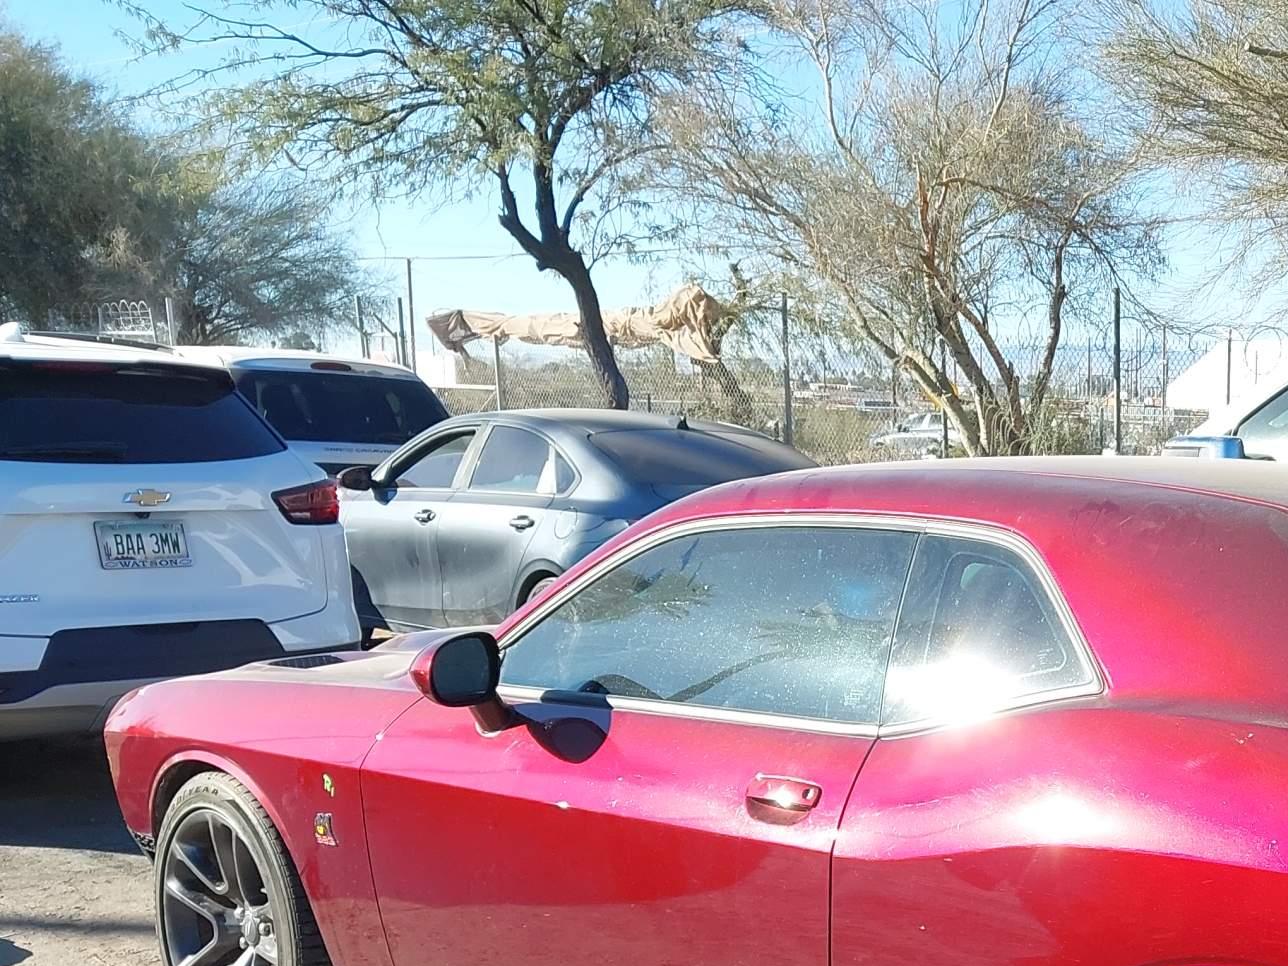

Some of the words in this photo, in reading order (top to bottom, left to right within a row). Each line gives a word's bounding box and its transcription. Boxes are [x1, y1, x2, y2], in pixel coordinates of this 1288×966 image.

[114, 534, 145, 555] BAA
[149, 533, 181, 554] 3MW
[119, 559, 178, 568] WATSON
